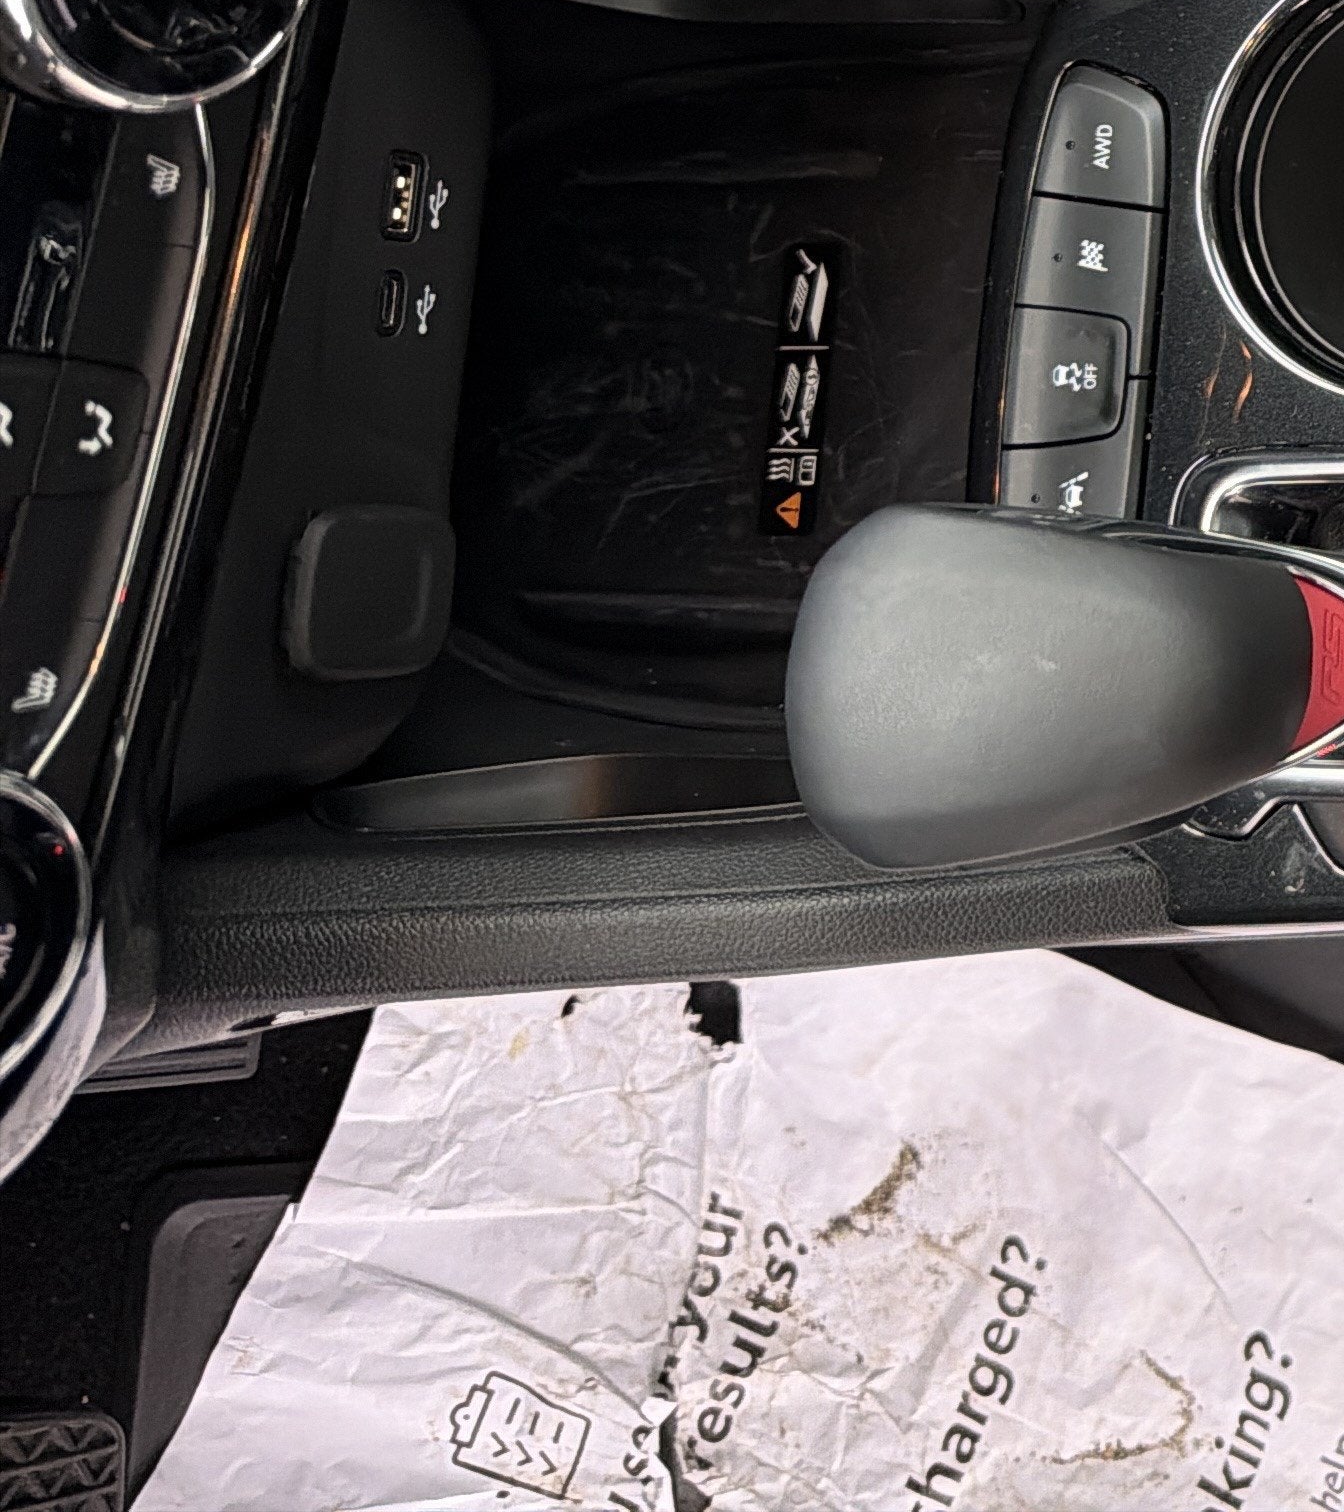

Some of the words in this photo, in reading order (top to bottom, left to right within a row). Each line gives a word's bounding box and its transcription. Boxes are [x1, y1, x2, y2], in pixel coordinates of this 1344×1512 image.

[1092, 123, 1113, 170] AWD
[1083, 363, 1099, 389] OFF
[1196, 1328, 1293, 1511] king?
